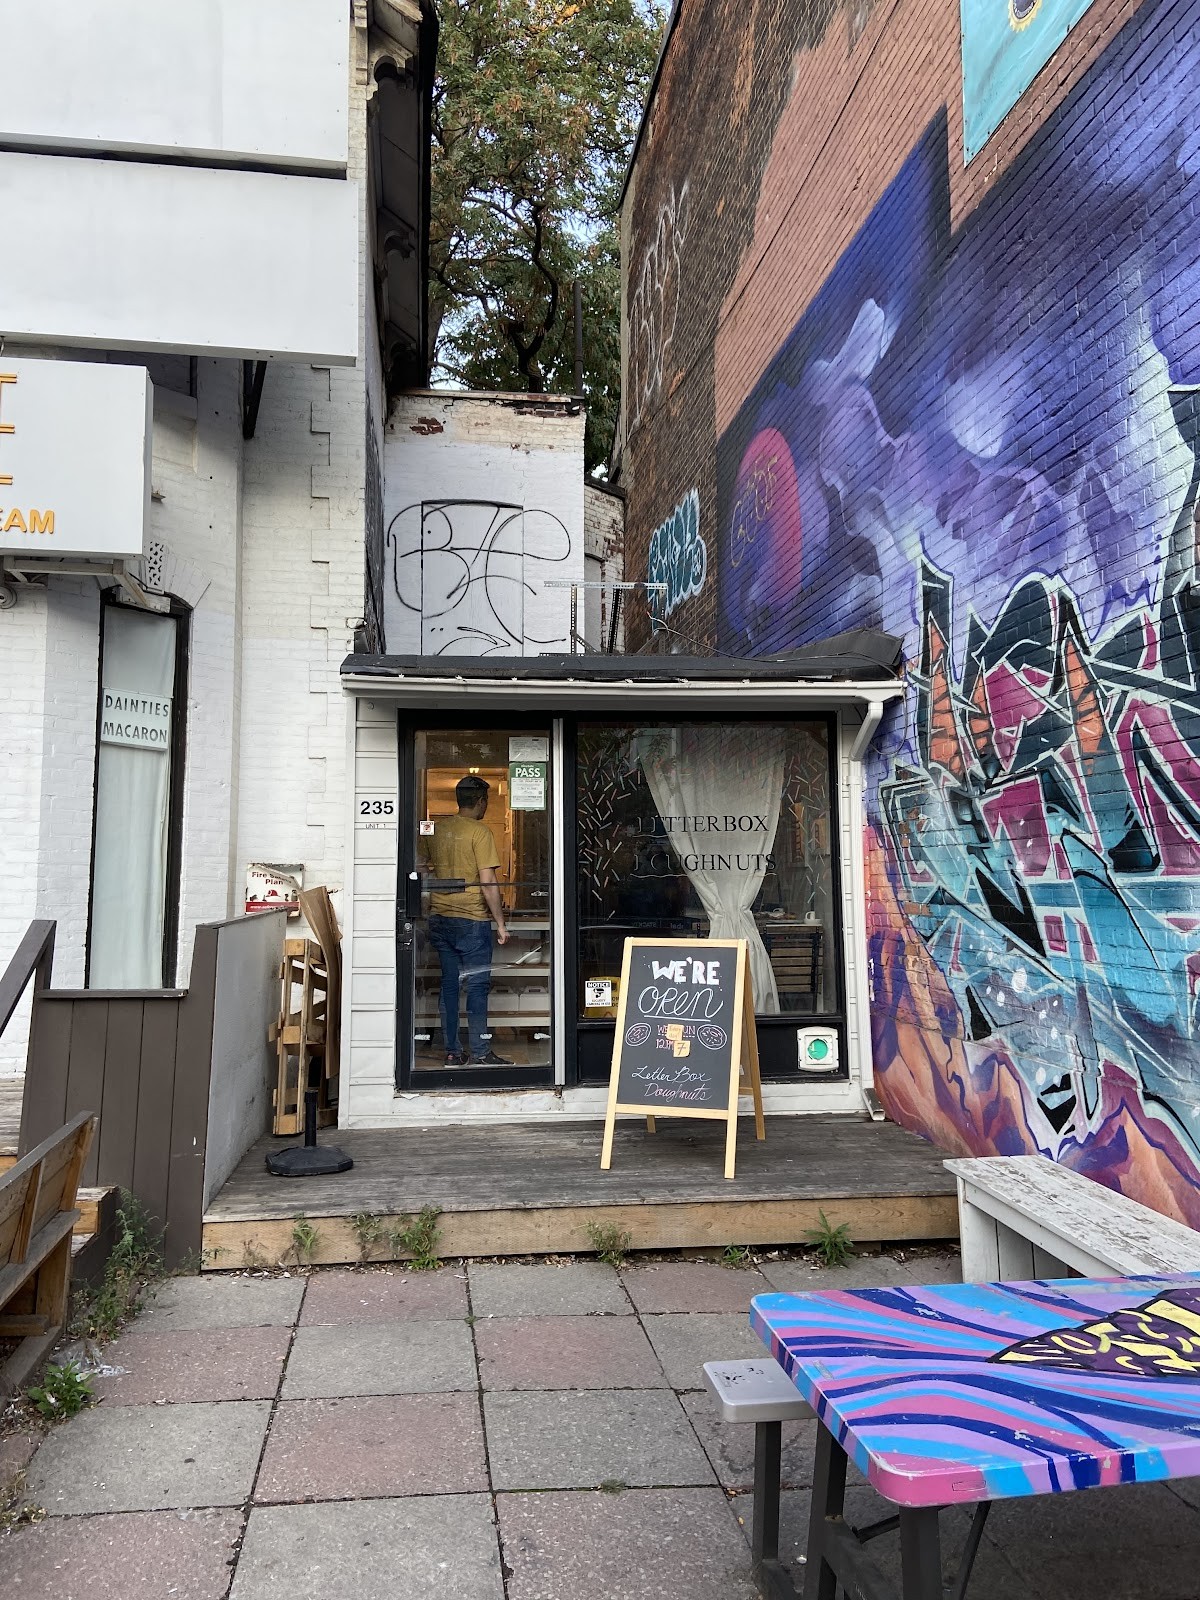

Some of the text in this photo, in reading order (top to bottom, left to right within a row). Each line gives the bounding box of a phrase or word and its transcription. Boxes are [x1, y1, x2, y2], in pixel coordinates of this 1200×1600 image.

[0, 508, 54, 534] AM
[105, 694, 169, 717] DAINTIES
[102, 721, 167, 743] MACARON
[515, 767, 541, 778] PASS
[360, 800, 394, 815] 235
[651, 956, 720, 986] WE'RE
[673, 1066, 712, 1083] Box
[644, 1083, 712, 1103] Doughnuts
